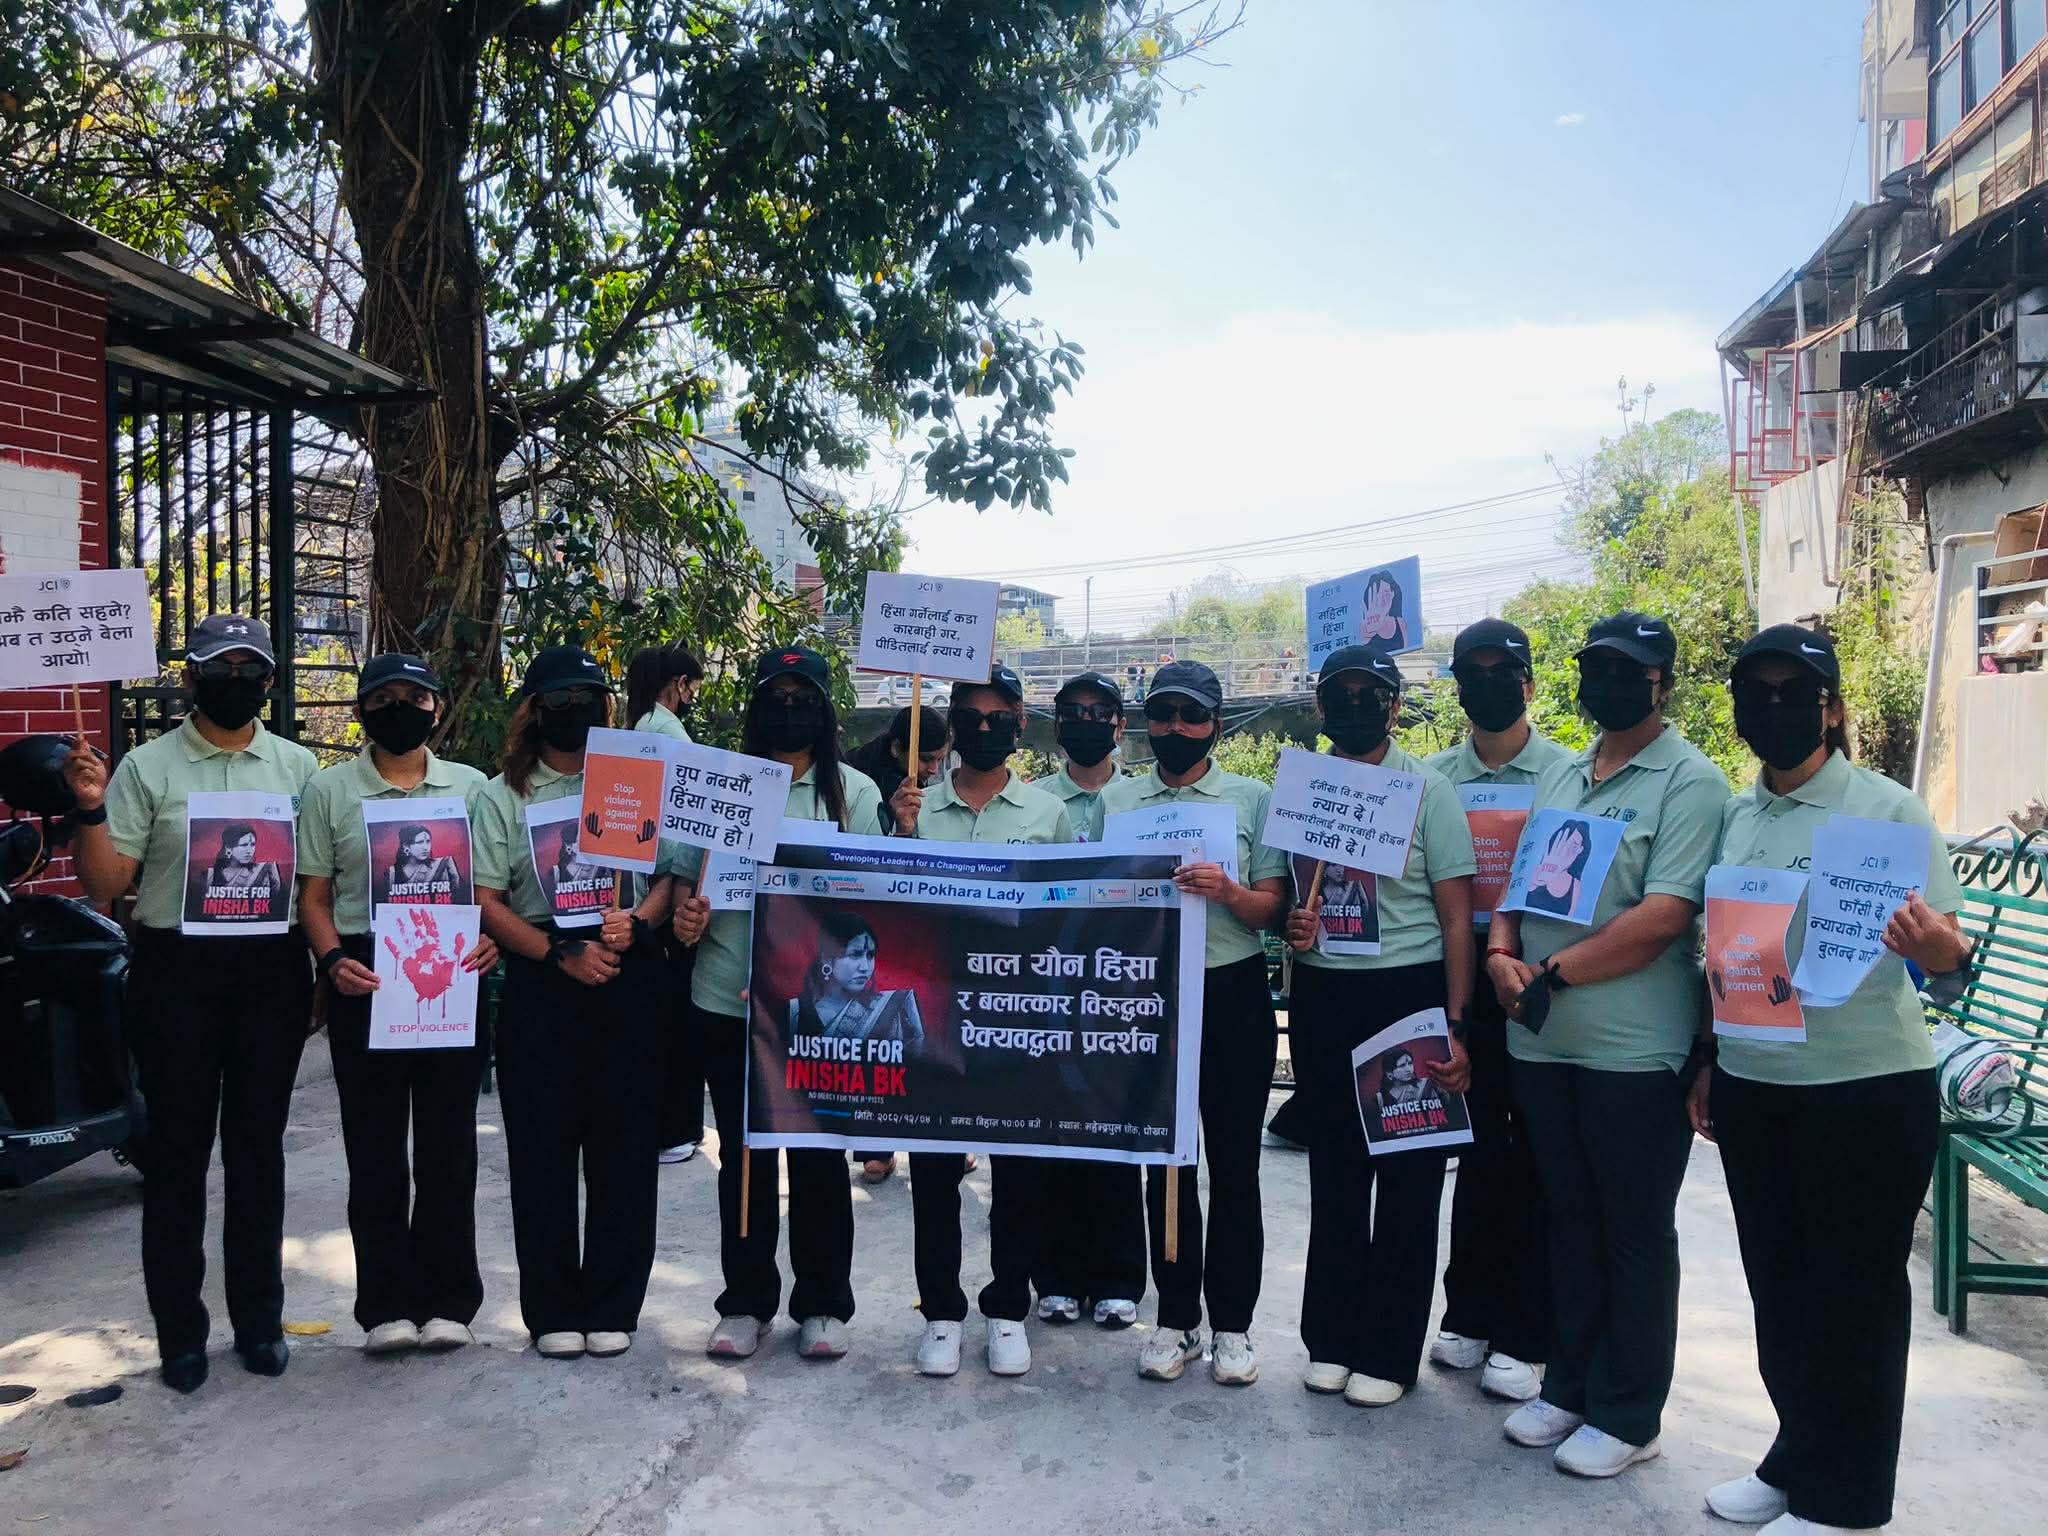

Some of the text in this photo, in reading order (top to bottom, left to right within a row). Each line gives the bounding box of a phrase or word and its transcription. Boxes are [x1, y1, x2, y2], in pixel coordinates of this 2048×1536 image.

[38, 580, 58, 592] JCI
[918, 583, 934, 592] JCI
[32, 603, 72, 621] कति
[78, 600, 131, 621] सहने?
[880, 602, 906, 619] हिंसा
[954, 613, 978, 625] कडा
[1318, 605, 1348, 620] महिला
[27, 632, 44, 646] त
[50, 625, 93, 647] उठ्ने
[41, 649, 91, 667] आयो!
[932, 645, 962, 658] न्याय
[676, 764, 701, 785] चुप
[760, 767, 773, 776] JCI
[614, 783, 634, 794] Stop
[1387, 779, 1404, 789] JCI
[604, 795, 642, 807] violence
[669, 785, 753, 826] हिंसा सहनु
[1471, 795, 1487, 803] JCI
[1312, 797, 1349, 816] न्याय
[605, 808, 640, 820] against
[1156, 814, 1169, 823] JCI
[604, 821, 637, 832] women
[664, 814, 719, 839] अपराध
[1162, 828, 1205, 840] सरकार
[1304, 830, 1341, 849] फाँसी
[1473, 837, 1500, 847] Stop
[1474, 850, 1511, 859] olence
[881, 856, 914, 867] Leaders
[916, 859, 928, 867] for
[936, 861, 976, 873] Changing
[1476, 861, 1509, 873] gainst
[1786, 856, 1811, 869] JC
[1861, 857, 1879, 868] JCI
[555, 877, 613, 894] JUSTICE FOR
[763, 873, 786, 887] JCI
[1740, 882, 1758, 892] JCI
[205, 886, 271, 899] JUSTICE FOR
[389, 881, 450, 895] JUSTICE FOR
[887, 881, 913, 895] JCI
[918, 882, 982, 899] Pokhara
[987, 885, 1025, 905] Lady
[1138, 886, 1159, 897] JCI
[203, 898, 271, 914] INISHA BK
[555, 892, 597, 909] INISHA
[1345, 905, 1361, 917] FOR
[1839, 899, 1872, 917] फाँसी
[1810, 916, 1863, 938] न्यायको
[967, 945, 1158, 981] बाल यौन हिंसा
[957, 991, 974, 1011] र
[979, 992, 1075, 1015] बलात्कार
[389, 1022, 469, 1033] STOP VIOLENCE
[1414, 1024, 1427, 1033] JCI
[1082, 1026, 1160, 1055] प्रदर्शन
[789, 1034, 904, 1063] JUSTICE FOR
[785, 1059, 907, 1097] INISHA BK
[1381, 1099, 1443, 1118] JUSTICE FOR
[1383, 1113, 1426, 1132] INISHA
[30, 1133, 75, 1146] HONDA
